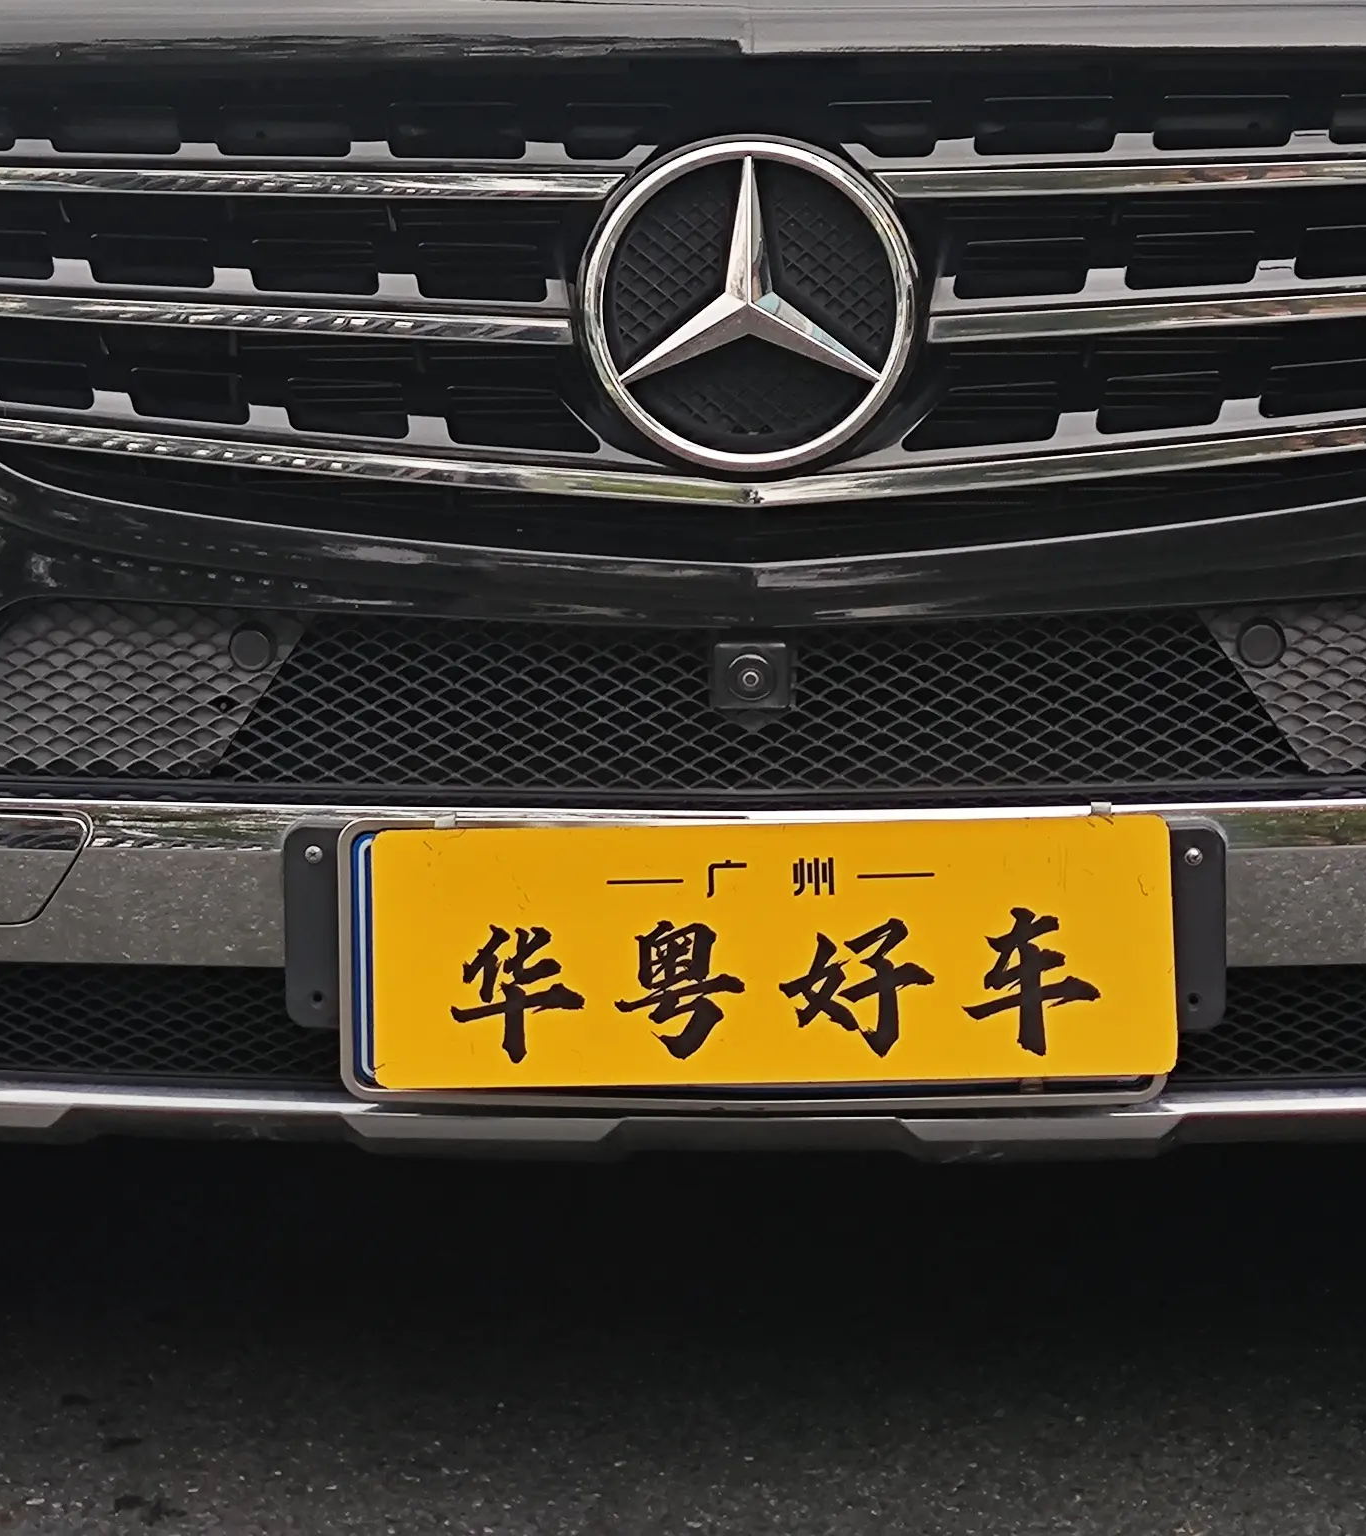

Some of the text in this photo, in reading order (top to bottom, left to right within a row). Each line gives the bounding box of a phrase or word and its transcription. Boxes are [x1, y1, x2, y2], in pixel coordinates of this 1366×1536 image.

[705, 857, 836, 898] 广州
[450, 907, 1101, 1064] 华粤好车
